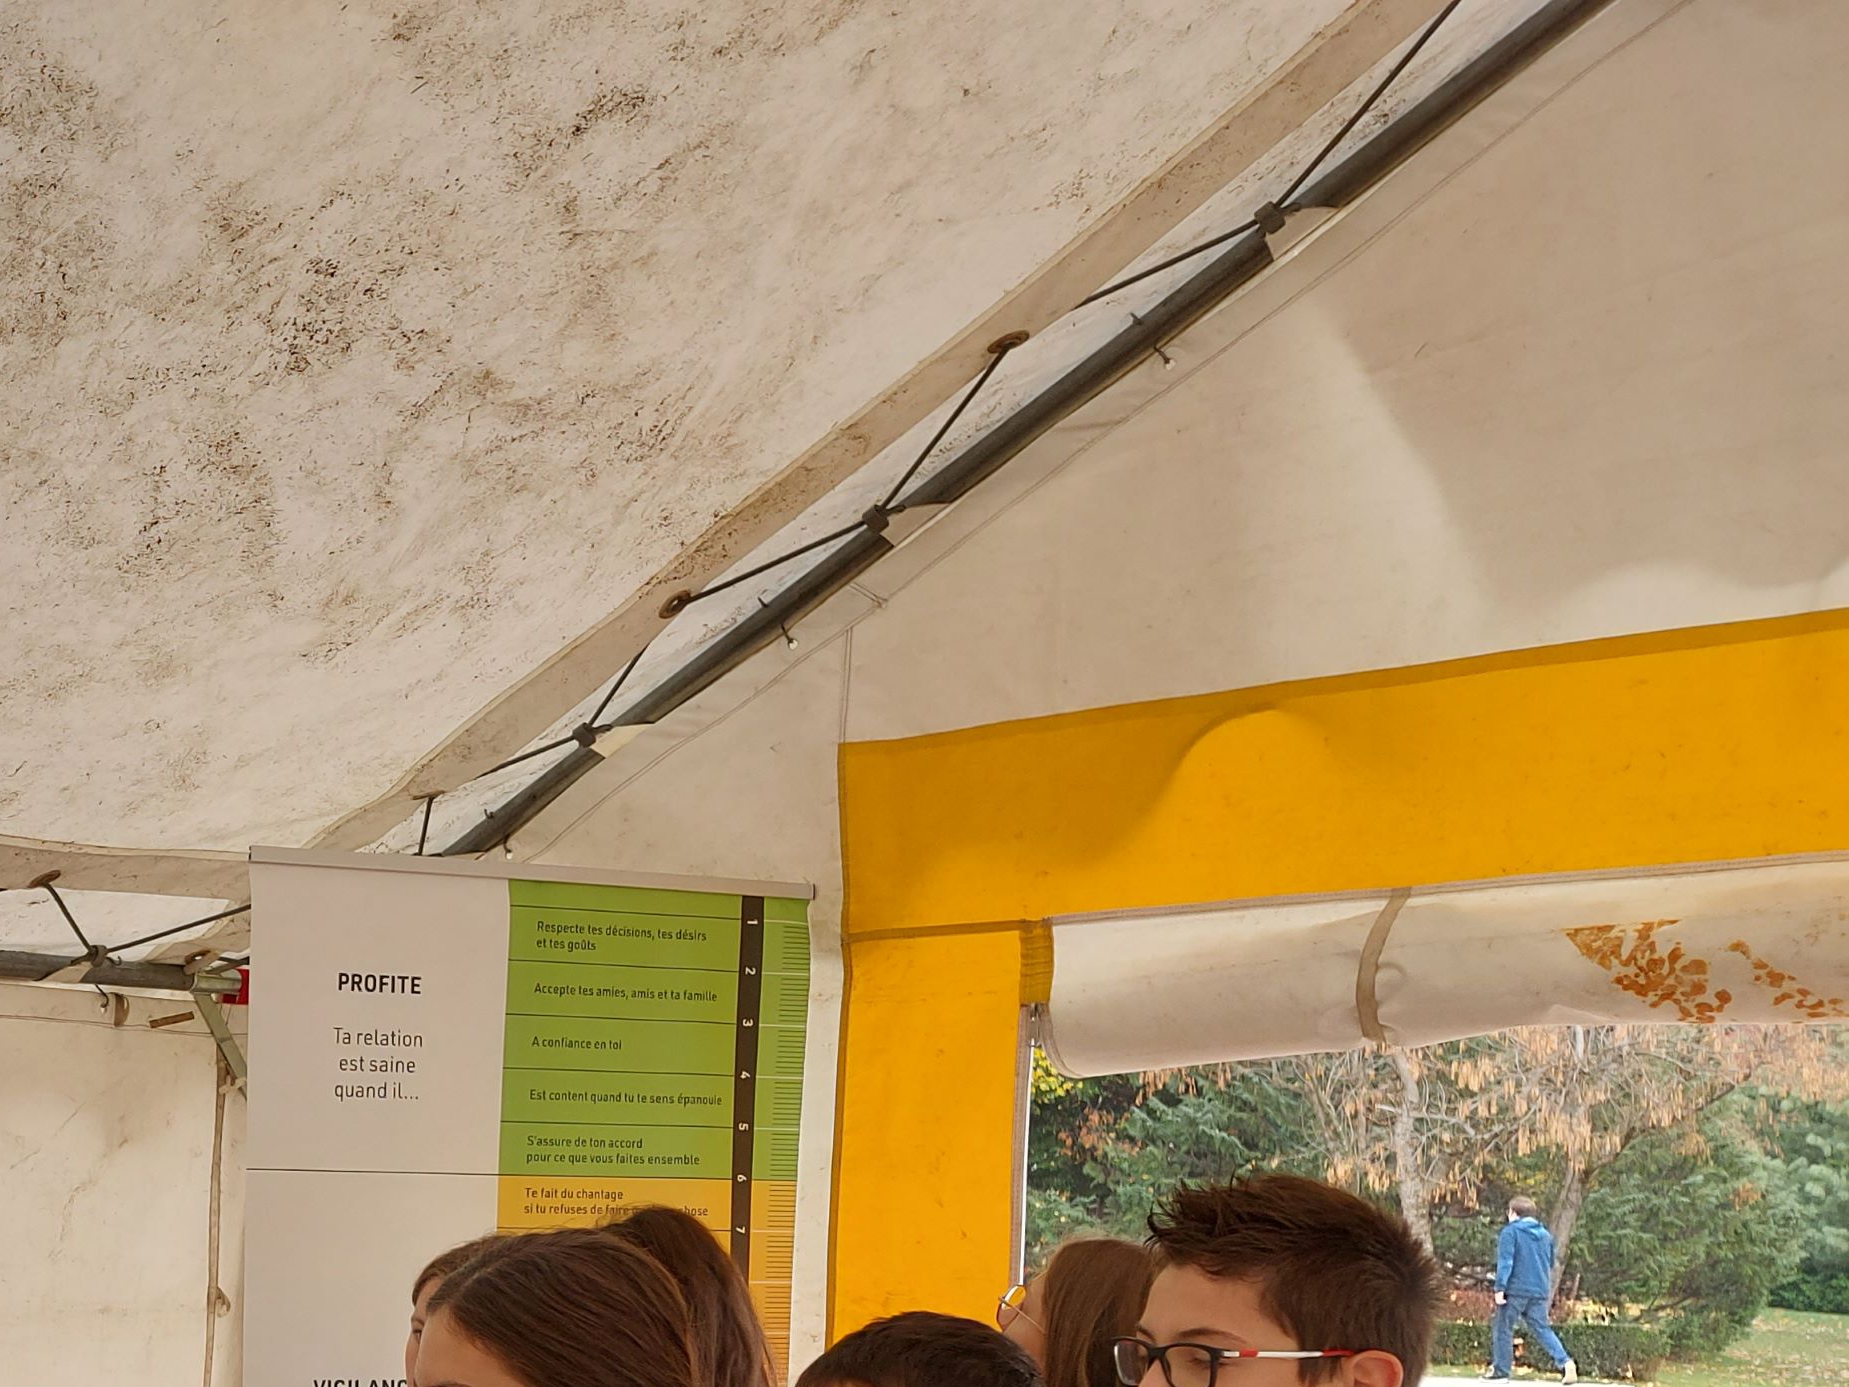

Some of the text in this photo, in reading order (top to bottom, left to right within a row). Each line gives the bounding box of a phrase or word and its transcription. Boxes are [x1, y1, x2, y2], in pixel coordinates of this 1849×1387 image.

[537, 921, 707, 941] Respecte tes décisions, tes désirs
[536, 938, 596, 952] et tes goûts
[338, 972, 422, 994] PROFITE
[534, 983, 717, 1002] Accepte tes amies, amis et ta famille
[333, 1027, 423, 1048] Ta relation
[532, 1036, 622, 1050] A confiance en toi
[339, 1056, 415, 1073] est saine
[334, 1082, 419, 1102] quand il...
[529, 1089, 722, 1108] Est content quand tu te sens épanouie
[527, 1136, 643, 1149] S'assure de ton accord
[526, 1153, 700, 1165] pour ce que vous faites ensemble
[525, 1187, 624, 1202] Te fait du chantage
[524, 1203, 533, 1214] si
[535, 1204, 546, 1214] tu
[549, 1204, 587, 1215] refuses
[590, 1204, 602, 1215] de
[605, 1206, 629, 1216] faire
[684, 1205, 709, 1216] hose
